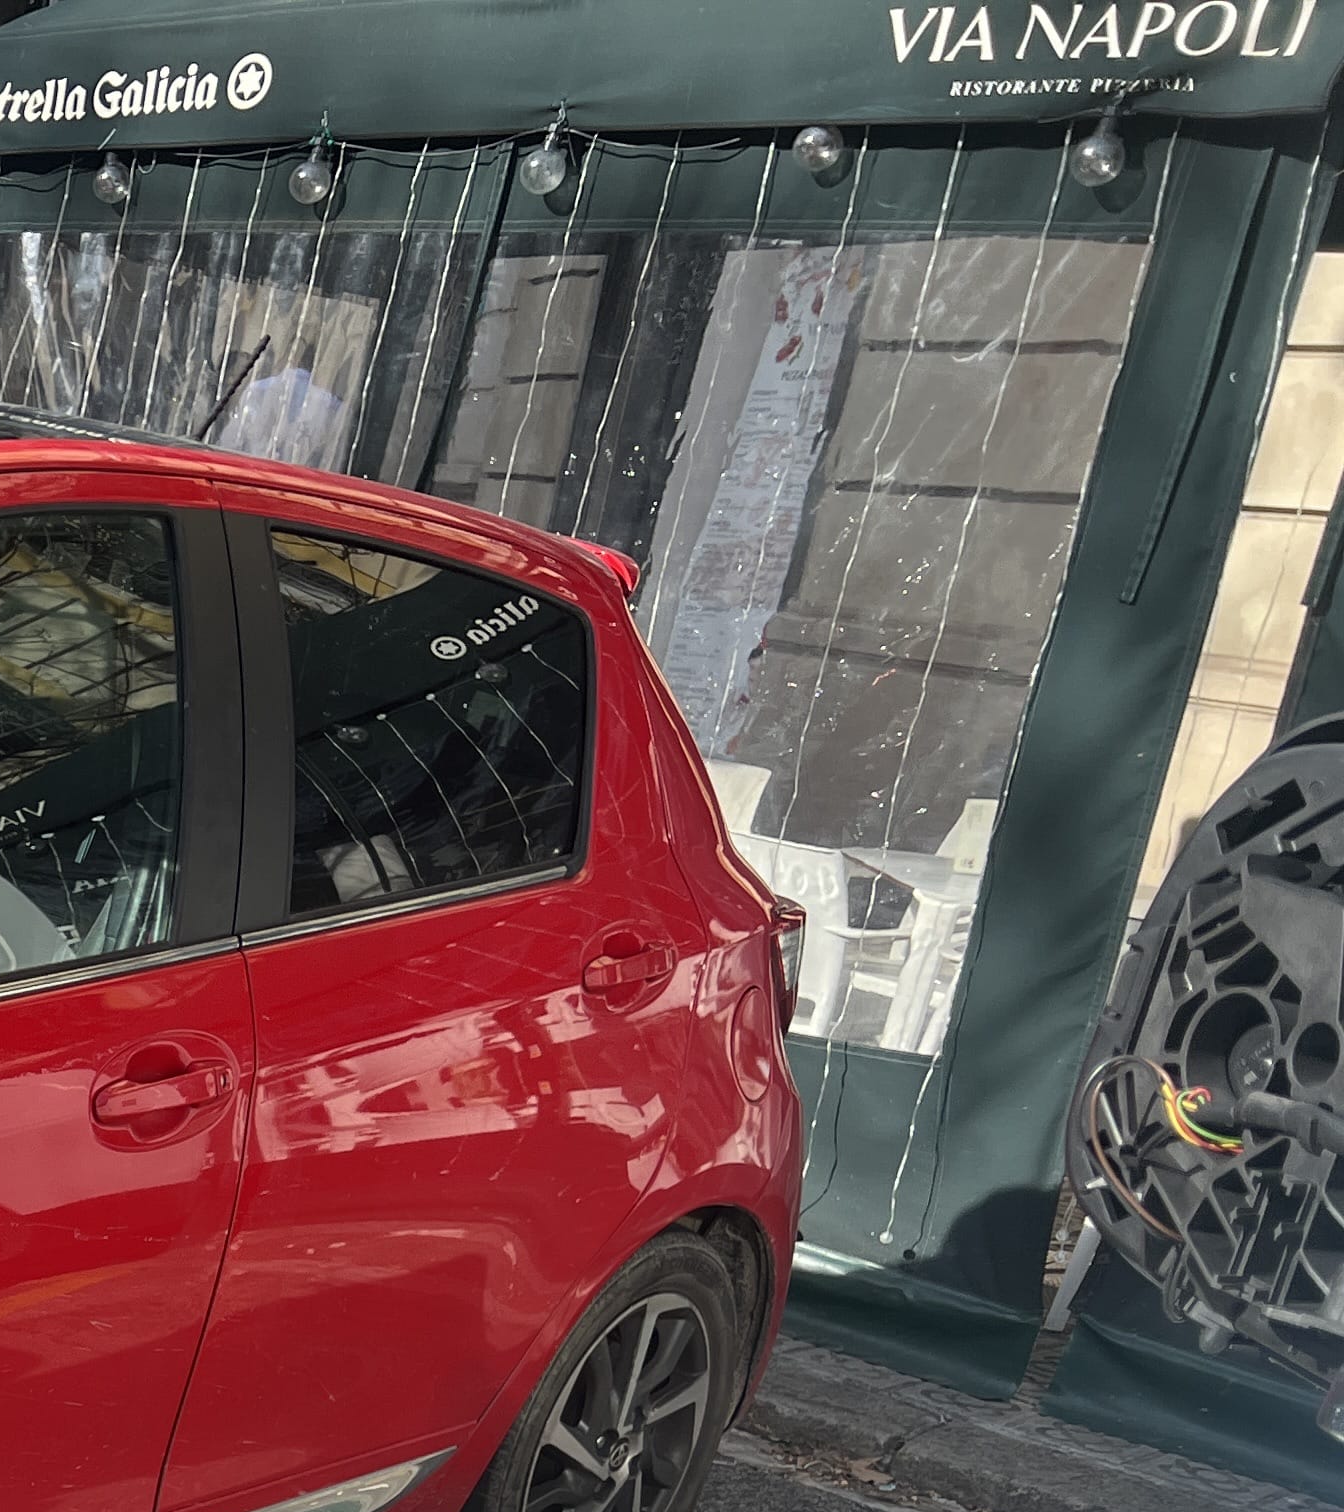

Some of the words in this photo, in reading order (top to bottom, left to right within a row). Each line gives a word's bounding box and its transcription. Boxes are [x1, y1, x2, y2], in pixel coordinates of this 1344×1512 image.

[889, 6, 994, 63] VIA
[1015, 0, 1313, 60] NAPOLI
[93, 62, 218, 119] Galicia
[949, 78, 1082, 97] RISTORANTE
